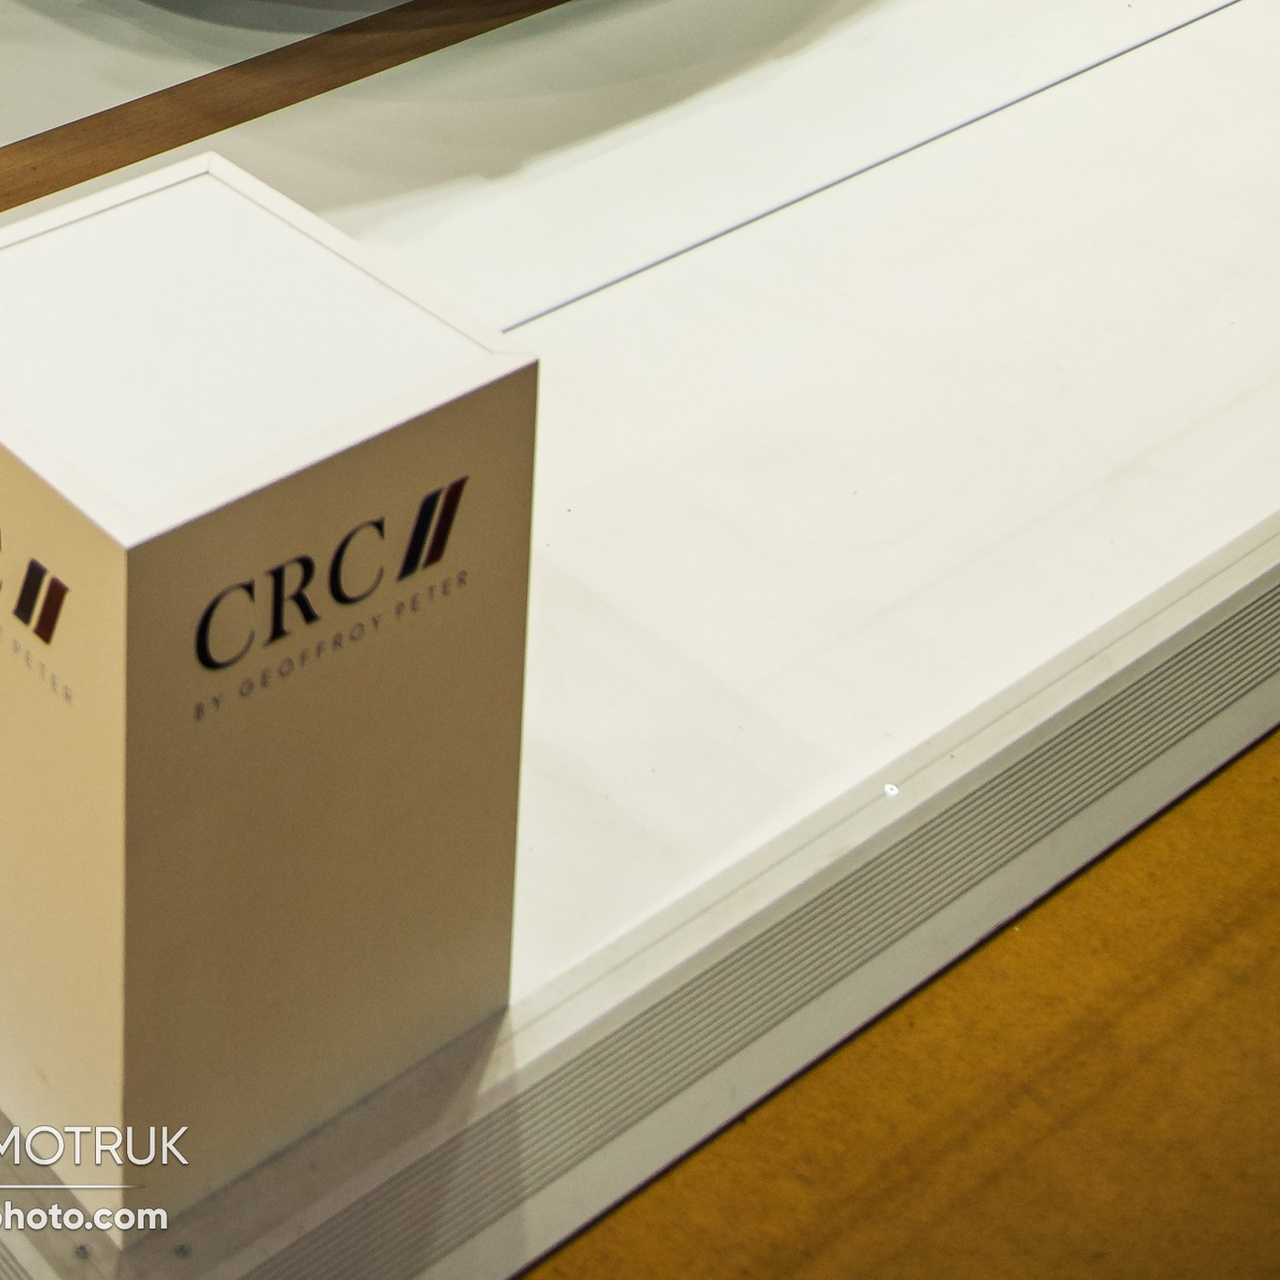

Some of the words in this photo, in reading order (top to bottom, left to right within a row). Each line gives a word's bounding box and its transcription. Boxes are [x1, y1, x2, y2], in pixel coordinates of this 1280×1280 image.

[192, 693, 225, 723] BY
[237, 611, 383, 701] GEOFFROY
[394, 568, 472, 623] PETER
[194, 516, 386, 672] CRC
[13, 639, 75, 707] PETER
